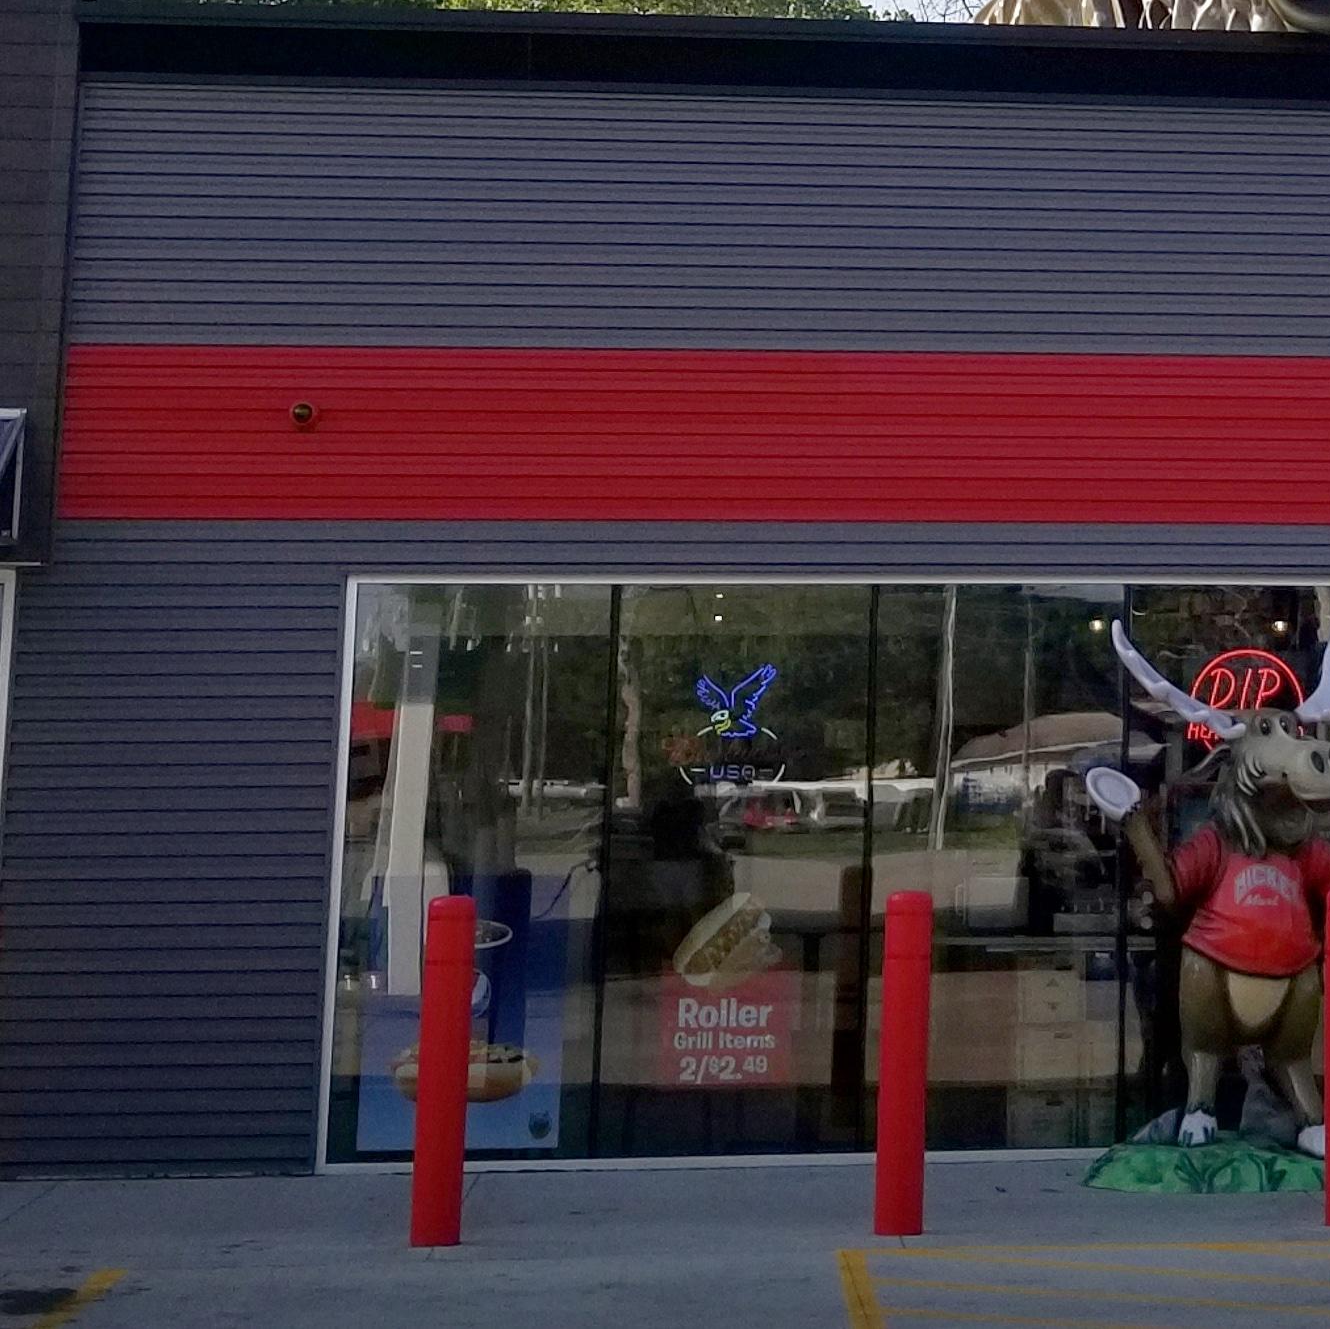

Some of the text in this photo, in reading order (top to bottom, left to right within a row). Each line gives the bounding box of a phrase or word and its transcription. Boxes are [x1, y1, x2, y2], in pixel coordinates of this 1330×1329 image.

[1210, 667, 1281, 711] DIP
[709, 764, 756, 781] USA
[678, 997, 774, 1028] Roller
[673, 1030, 776, 1050] Grill Items
